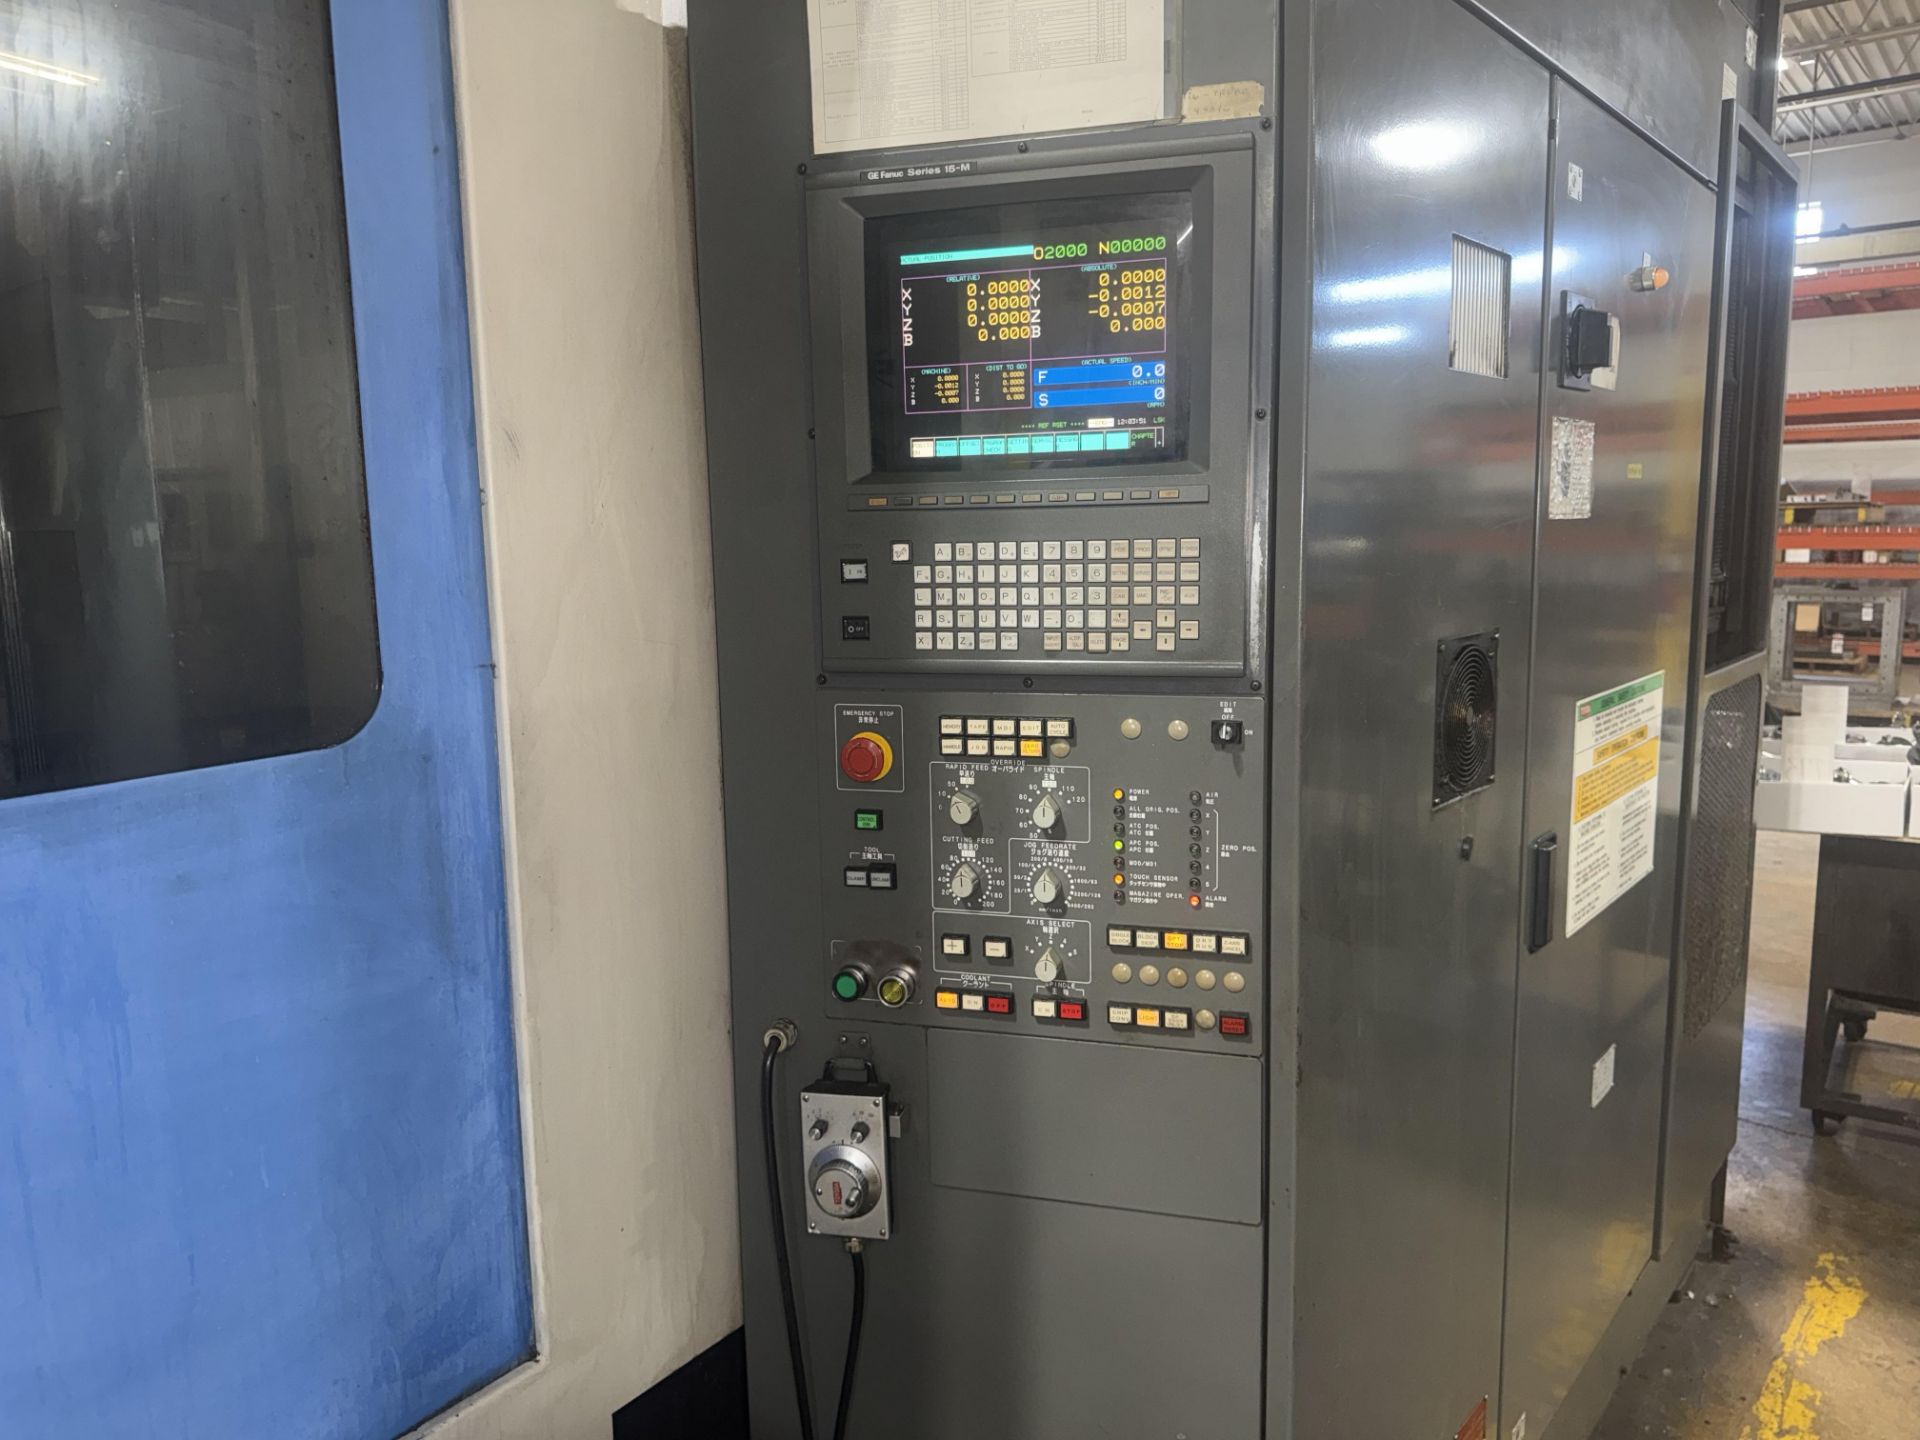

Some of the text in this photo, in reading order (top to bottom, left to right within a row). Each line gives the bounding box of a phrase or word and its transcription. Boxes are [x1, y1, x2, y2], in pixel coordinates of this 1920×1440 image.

[868, 163, 970, 180] GE Fanuc Series 15-M
[1099, 236, 1166, 255] N00000
[1030, 268, 1166, 291] X 0.0000
[902, 279, 1030, 301] X 0.0000
[1030, 284, 1166, 307] Y -0.0012
[902, 295, 1030, 316] Y 0.0000
[1031, 300, 1166, 323] Z -0.0007
[903, 310, 1030, 331] Z 0.0000
[1031, 316, 1166, 338] B 0.000
[903, 326, 1030, 347] B 0.000
[1038, 363, 1165, 384] F 0.0
[1038, 387, 1165, 407] S 0
[937, 548, 943, 556] A
[958, 547, 965, 555] B
[979, 547, 987, 555] C
[1001, 547, 1008, 555] D
[1023, 547, 1030, 555] E
[1071, 546, 1078, 554] 8
[1093, 546, 1101, 554] 9
[916, 570, 922, 578] F
[937, 571, 945, 579] G
[959, 570, 965, 578] H
[1023, 570, 1030, 578] K
[1049, 569, 1055, 577] 4
[1070, 569, 1078, 577] 5
[1093, 569, 1101, 577] 6
[917, 593, 922, 601] L
[937, 593, 945, 601] M
[1002, 592, 1009, 600] P
[1023, 592, 1031, 601] Q
[1071, 592, 1078, 600] 2
[1094, 592, 1101, 600] 3
[938, 615, 945, 623] S
[960, 614, 966, 622] T
[1023, 614, 1031, 622] W
[918, 637, 924, 645] X
[960, 637, 966, 645] Z
[1034, 766, 1065, 774] SPINDLE
[1024, 841, 1077, 851] JOG FEEDRATE
[1221, 844, 1239, 852] ZERO
[1129, 890, 1162, 898] MAGAZINE
[1026, 918, 1075, 928] AXIS SELECT
